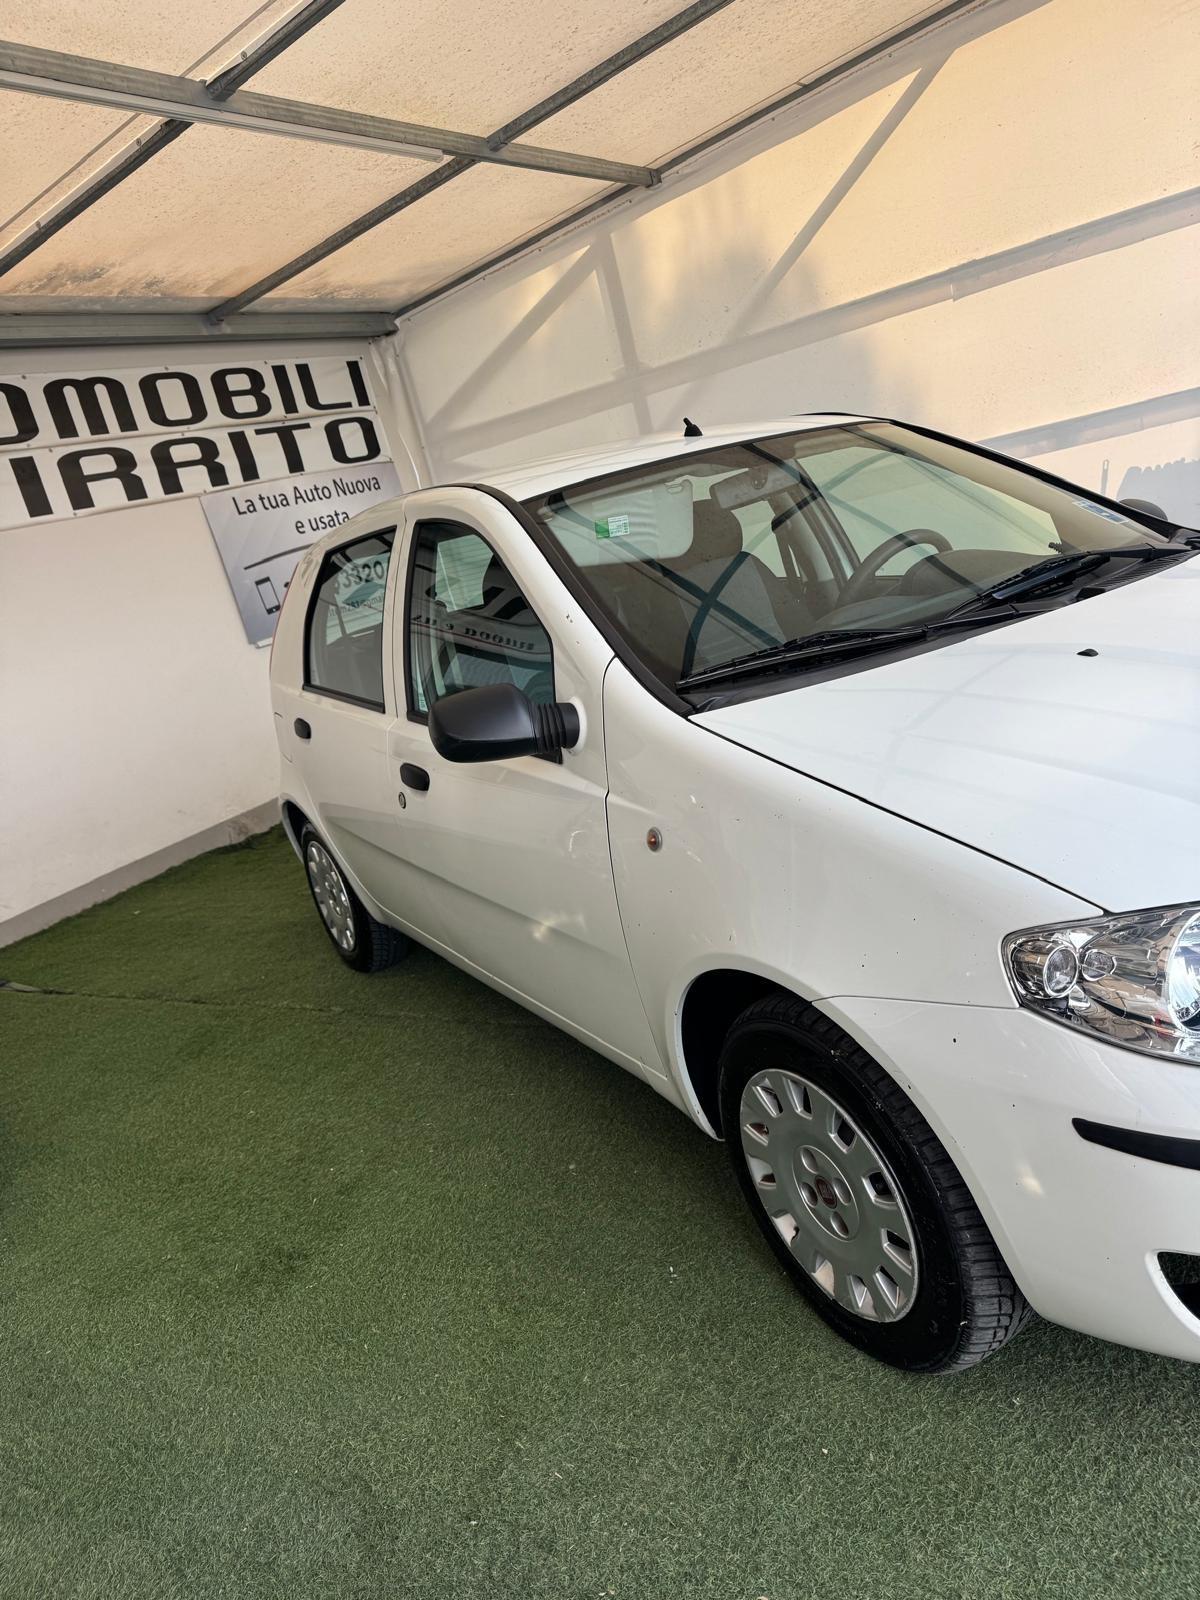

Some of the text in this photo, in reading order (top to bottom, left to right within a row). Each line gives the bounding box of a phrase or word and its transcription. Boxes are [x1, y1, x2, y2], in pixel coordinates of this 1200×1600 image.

[9, 416, 381, 518] IRRITO
[232, 475, 381, 516] La tua Auto Nuova
[295, 510, 350, 535] e usata
